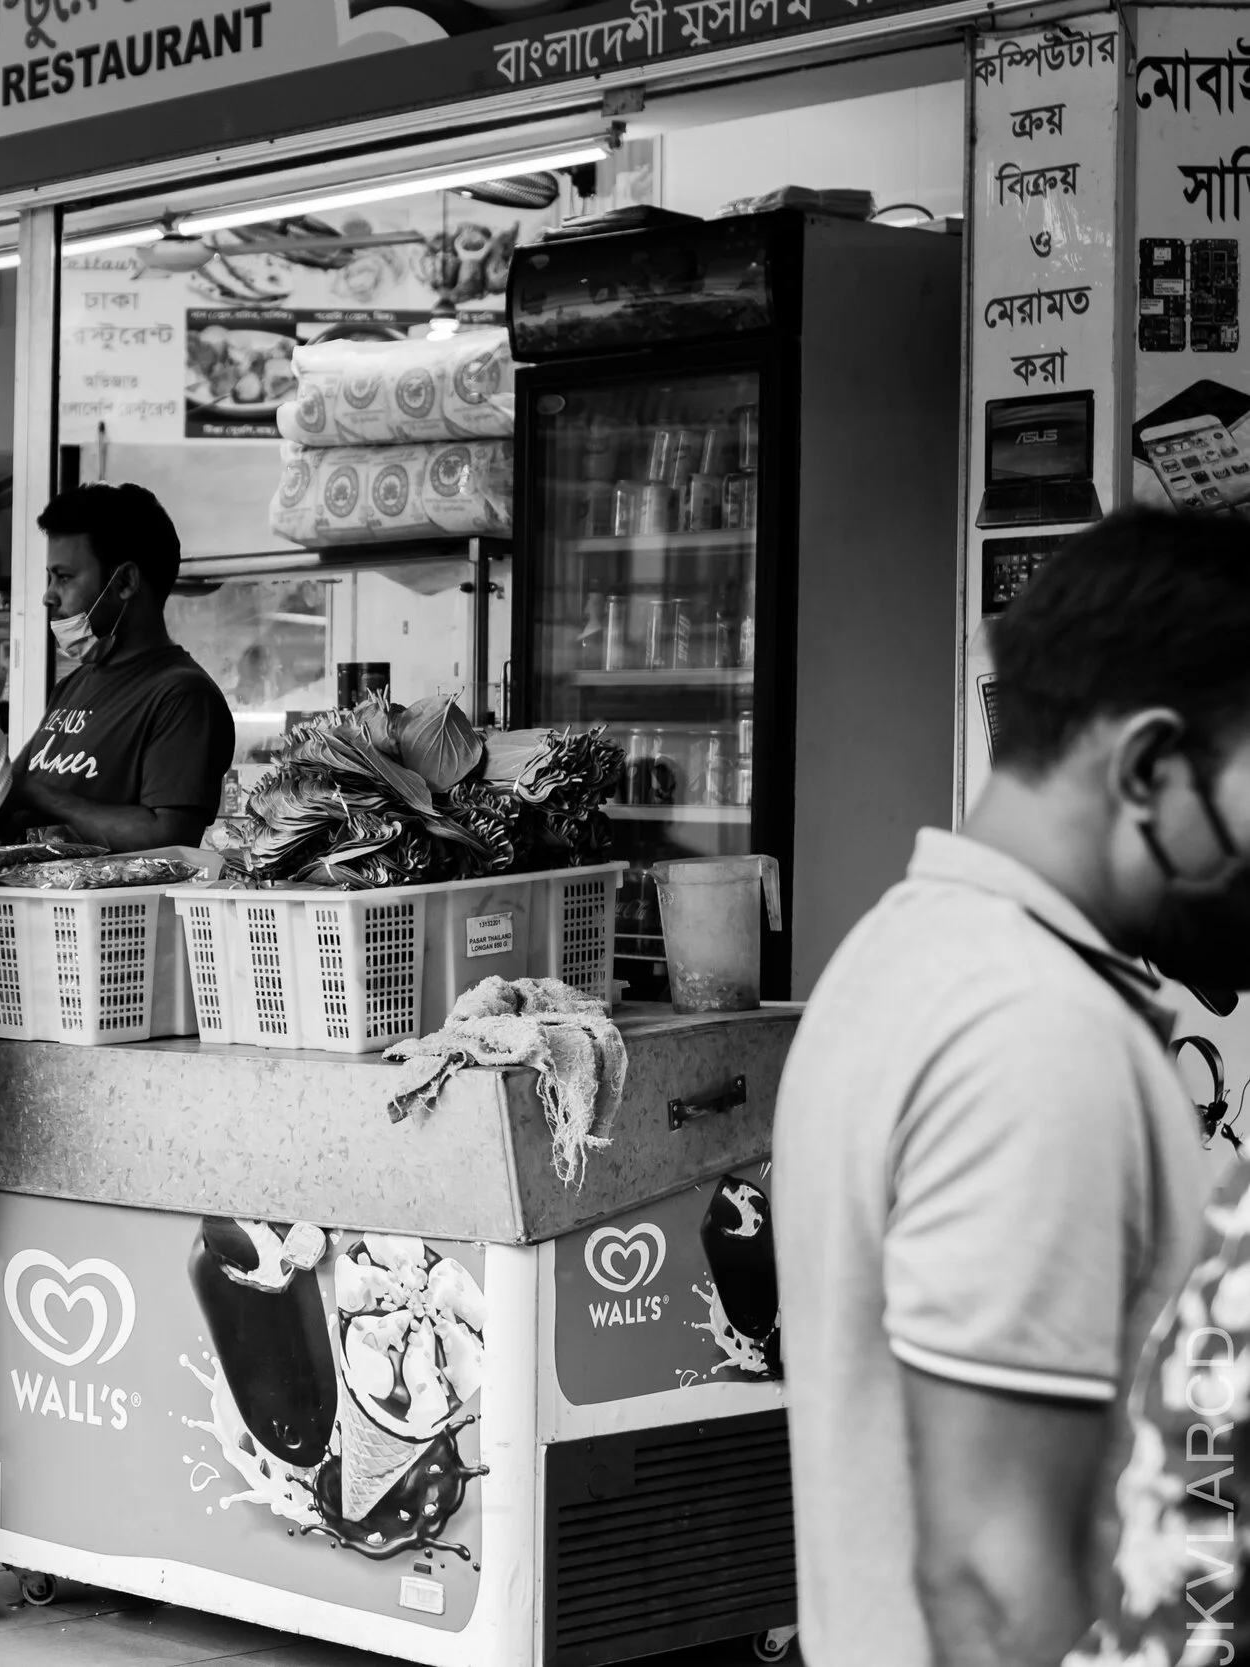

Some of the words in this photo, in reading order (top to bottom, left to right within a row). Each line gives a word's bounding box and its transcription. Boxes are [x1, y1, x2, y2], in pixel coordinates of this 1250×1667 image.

[2, 2, 271, 107] RESTAURANT
[975, 31, 1118, 86] কম্পিউটার
[1011, 103, 1067, 140] ক্রয়
[995, 162, 1080, 206] বিক্রয়
[1030, 231, 1052, 258] ও
[985, 286, 1092, 328] মেরামত
[1011, 347, 1068, 385] করা
[1015, 429, 1058, 445] ASUS
[469, 936, 486, 944] PASAR
[488, 933, 511, 941] THAILAND
[471, 943, 493, 952] LONGAN
[588, 1296, 661, 1328] WALL'S
[11, 1369, 128, 1430] WALL'S
